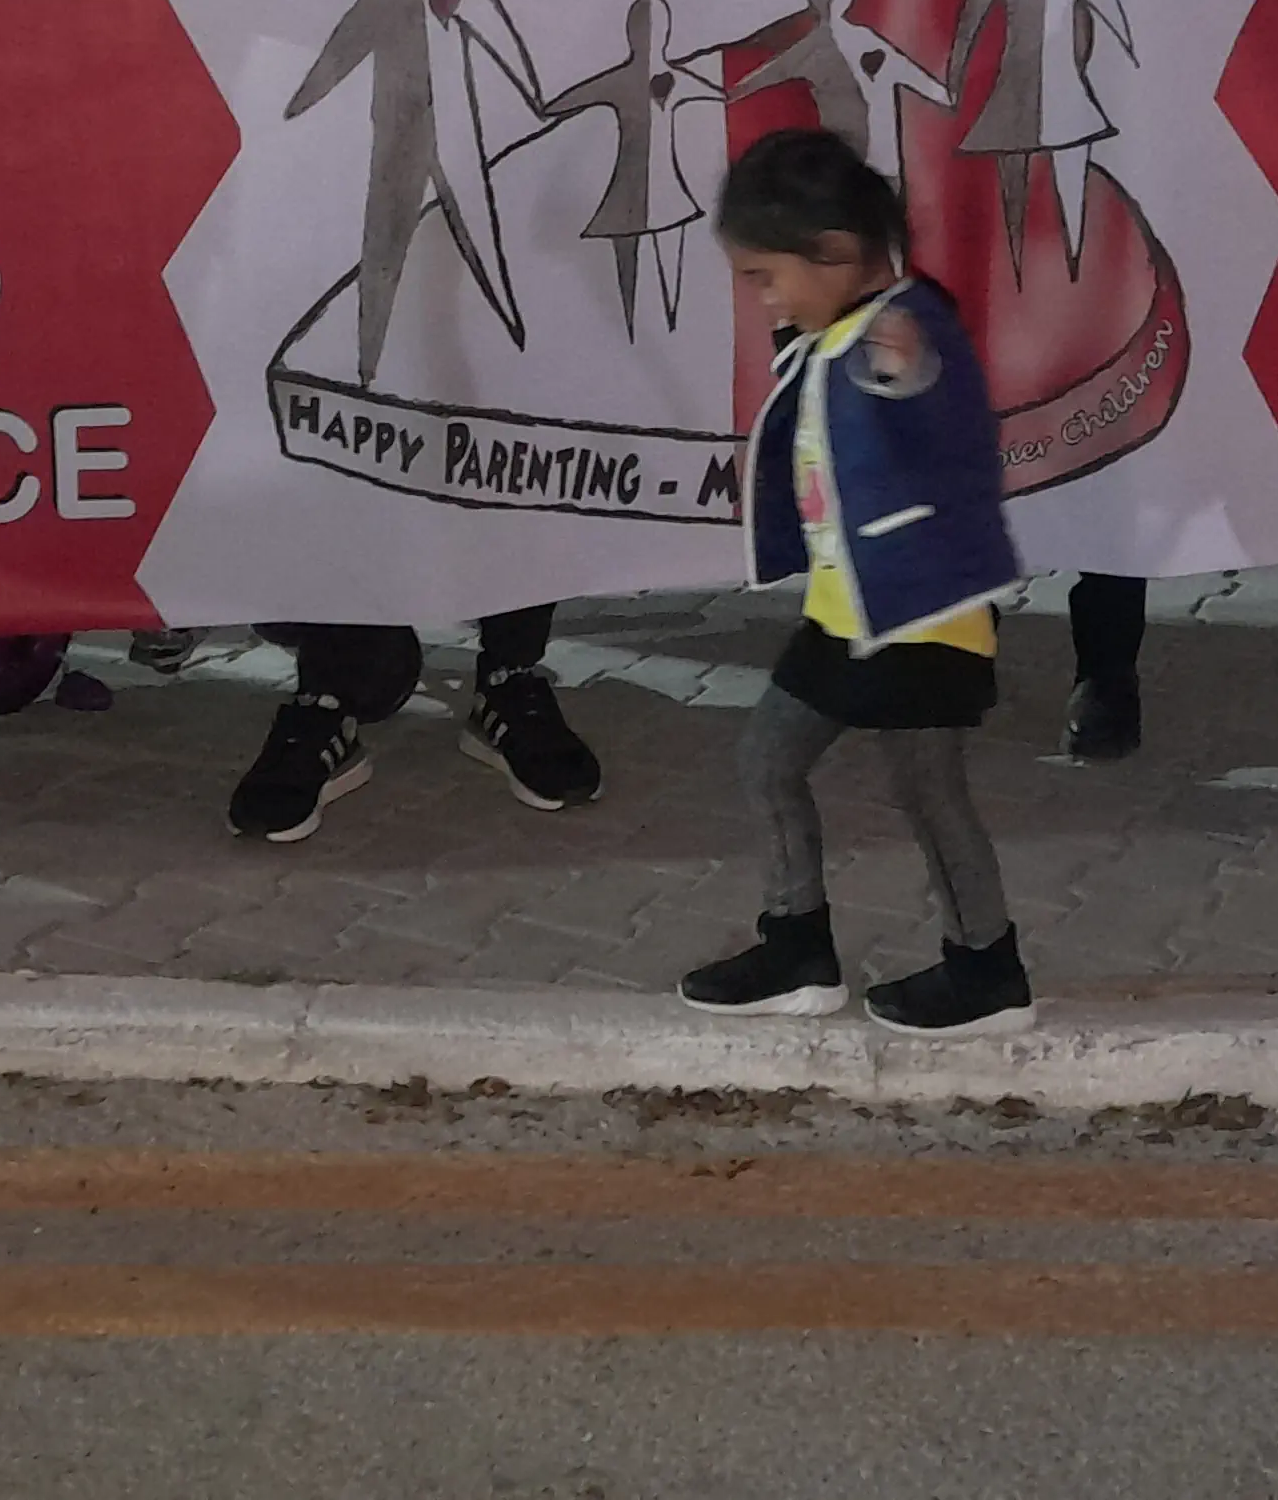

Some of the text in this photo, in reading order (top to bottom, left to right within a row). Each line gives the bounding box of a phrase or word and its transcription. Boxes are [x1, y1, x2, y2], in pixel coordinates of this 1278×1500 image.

[1060, 319, 1175, 446] Children
[288, 394, 425, 474] HAPPY
[443, 422, 642, 506] PARENTING
